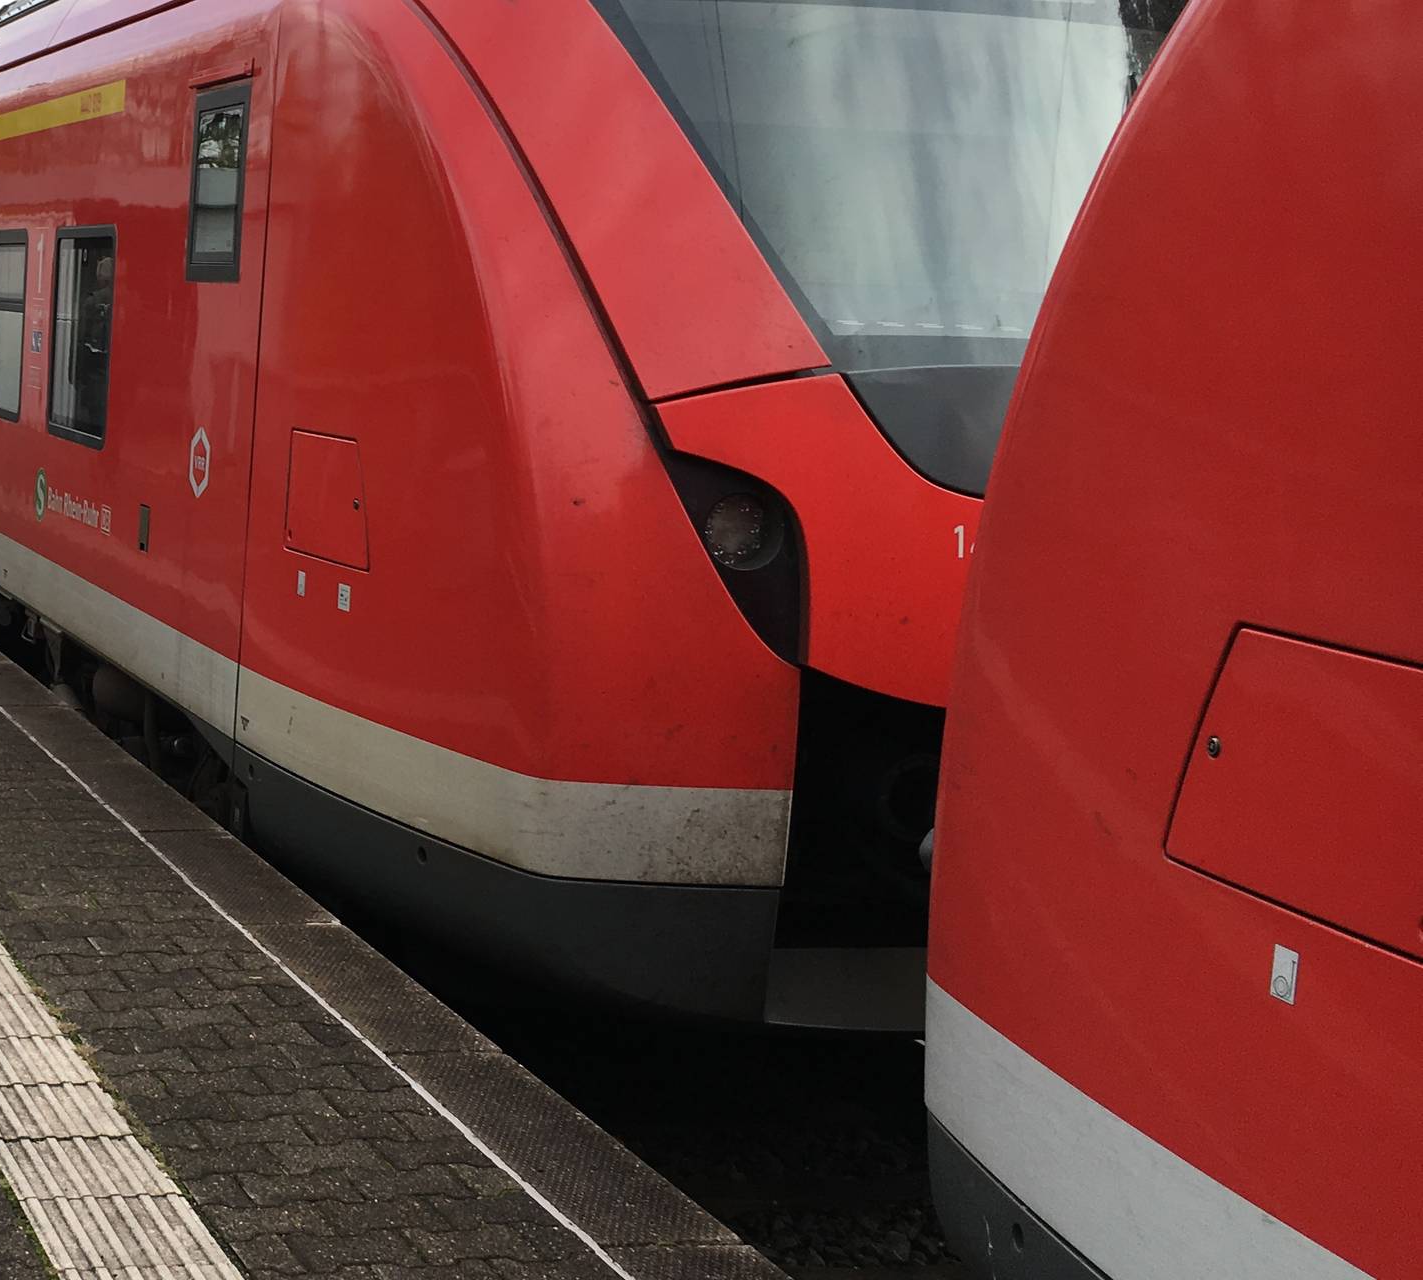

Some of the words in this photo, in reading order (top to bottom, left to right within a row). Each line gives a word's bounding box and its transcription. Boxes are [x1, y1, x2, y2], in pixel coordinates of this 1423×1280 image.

[194, 455, 206, 471] VRR
[36, 471, 46, 519] S
[47, 486, 63, 514] Bahn
[63, 492, 99, 528] Rhein-Ruhr
